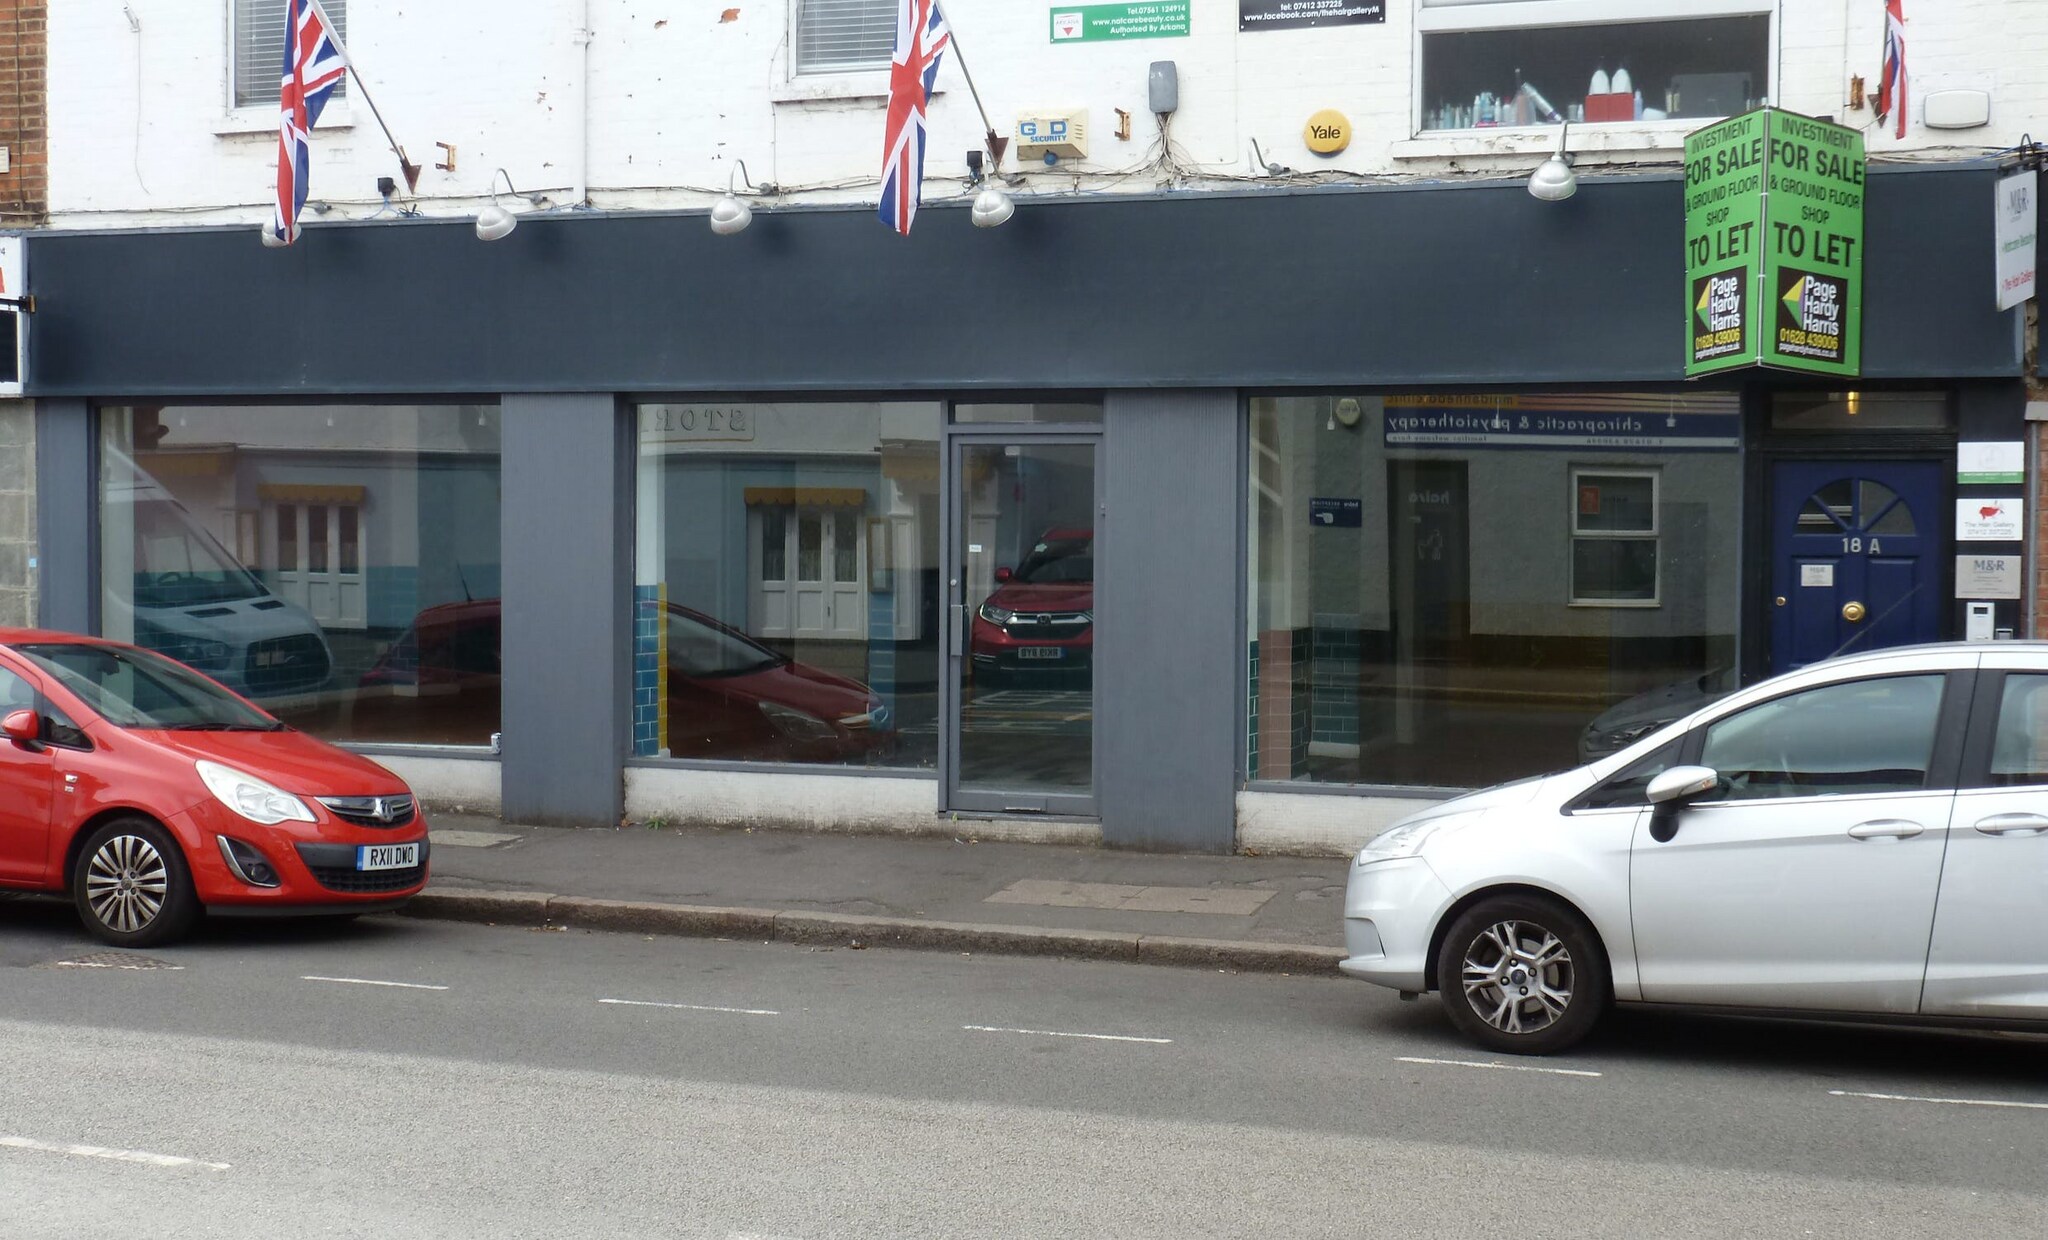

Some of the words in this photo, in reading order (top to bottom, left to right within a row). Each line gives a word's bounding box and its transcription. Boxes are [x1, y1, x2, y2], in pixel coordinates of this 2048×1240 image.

[1161, 4, 1186, 13] 124914
[1294, 2, 1316, 10] 07412
[1317, 0, 1343, 9] 337225
[1110, 26, 1148, 34] Authorised
[1020, 122, 1037, 136] G
[1050, 121, 1067, 135] D
[1030, 135, 1067, 143] SECURITY
[1310, 125, 1341, 139] Yale
[1692, 118, 1753, 155] INVESTMENT
[1782, 117, 1855, 150] INVESTMENT
[1685, 155, 1711, 189] FOR
[1716, 138, 1762, 176] SALE
[1770, 139, 1809, 171] FOR
[1816, 151, 1862, 186] SALE
[1692, 185, 1726, 209] GROUND
[1728, 175, 1759, 197] FLOOR
[1769, 175, 1778, 189] &
[1781, 178, 1827, 201] GROUND
[1830, 188, 1860, 209] FLOOR
[1706, 207, 1729, 227] SHOP
[1802, 206, 1830, 225] SHOP
[1689, 237, 1710, 269] TO
[1716, 221, 1754, 261] LET
[1773, 221, 1805, 257] TO
[1813, 230, 1855, 268] LET
[1710, 277, 1738, 298] Page
[1805, 276, 1836, 299] Page
[1710, 293, 1740, 315] Hardy
[1804, 295, 1840, 318] Hardy
[1710, 312, 1741, 333] Harris
[1803, 314, 1839, 336] Harris
[1780, 327, 1806, 345] 01628
[1806, 333, 1839, 350] 439006
[1842, 537, 1862, 553] 18
[1868, 538, 1881, 554] A
[1973, 559, 2005, 571] M&R
[370, 848, 393, 866] RX11
